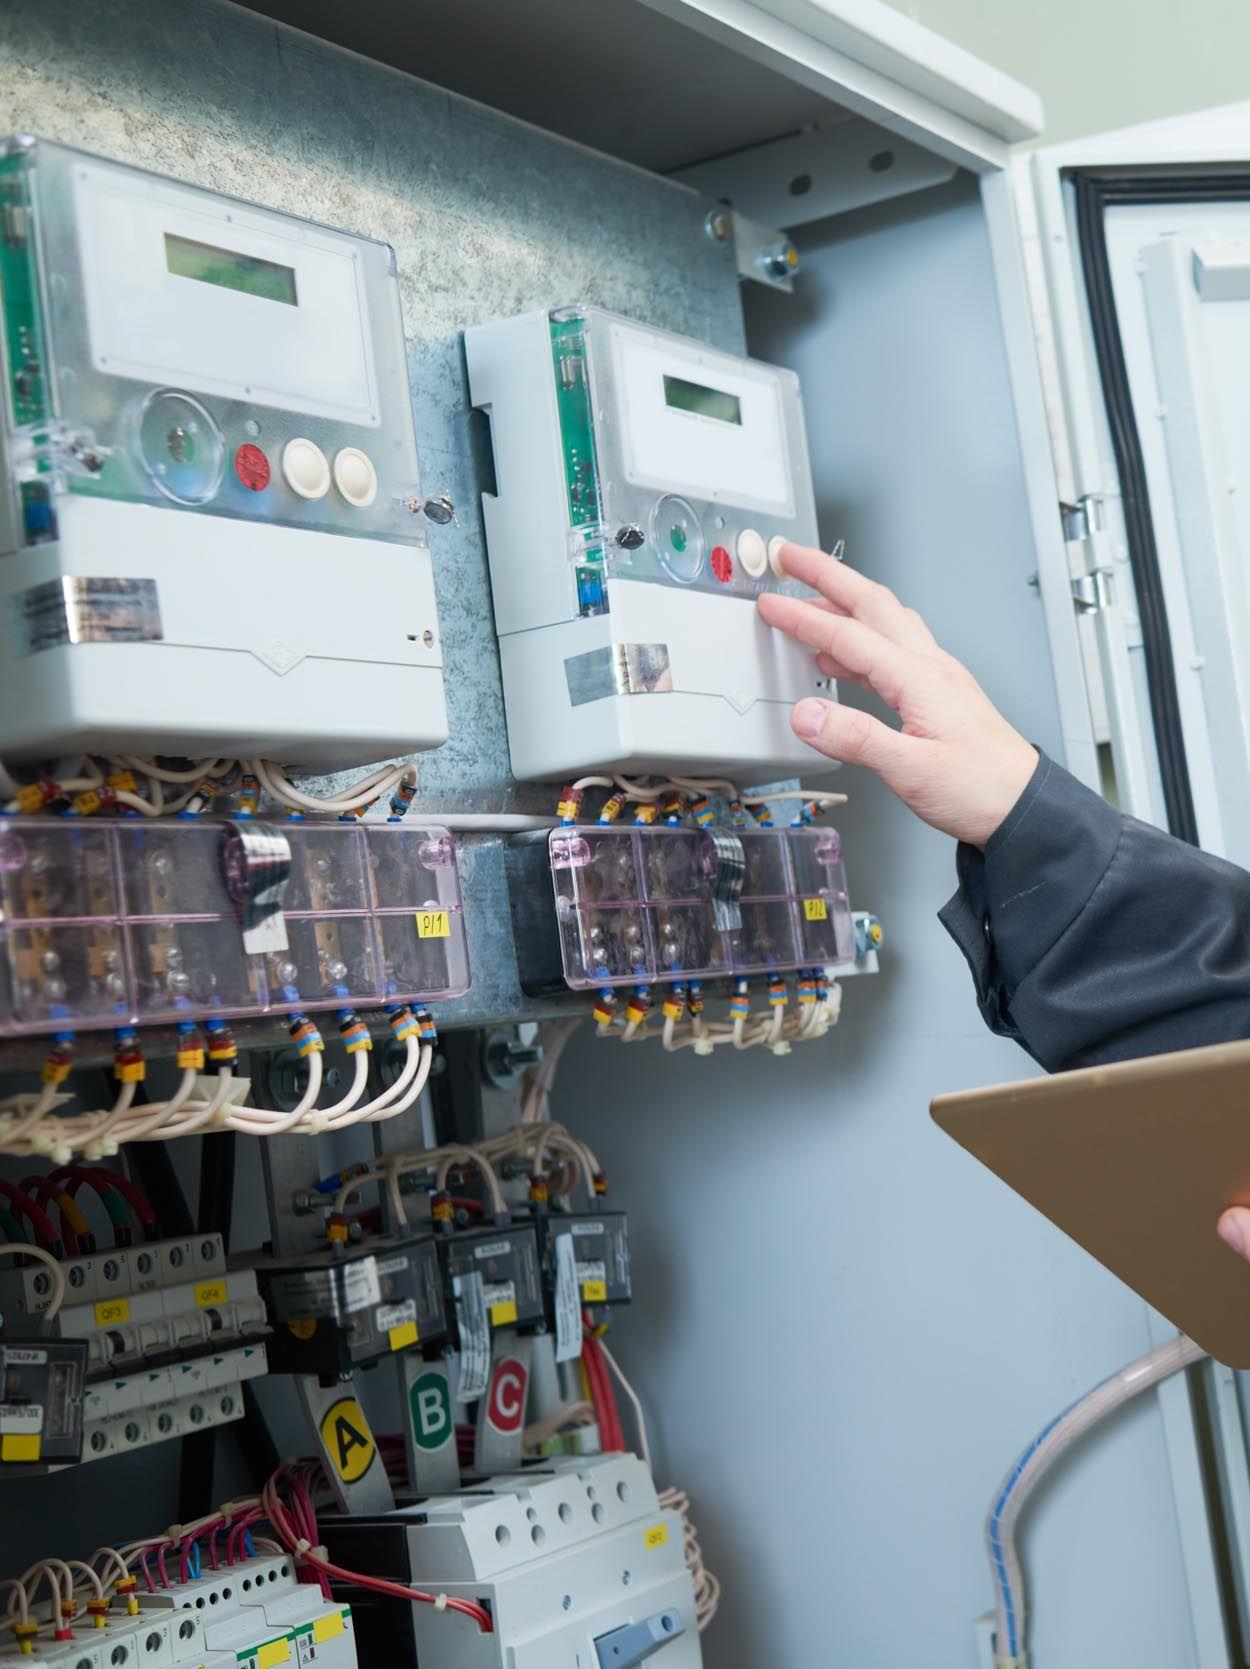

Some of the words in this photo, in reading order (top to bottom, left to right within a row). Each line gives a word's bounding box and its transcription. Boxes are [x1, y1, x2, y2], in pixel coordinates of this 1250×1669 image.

[101, 1306, 122, 1321] QF3
[417, 1387, 446, 1436] B
[496, 1373, 520, 1418] C
[334, 1415, 368, 1470] A
